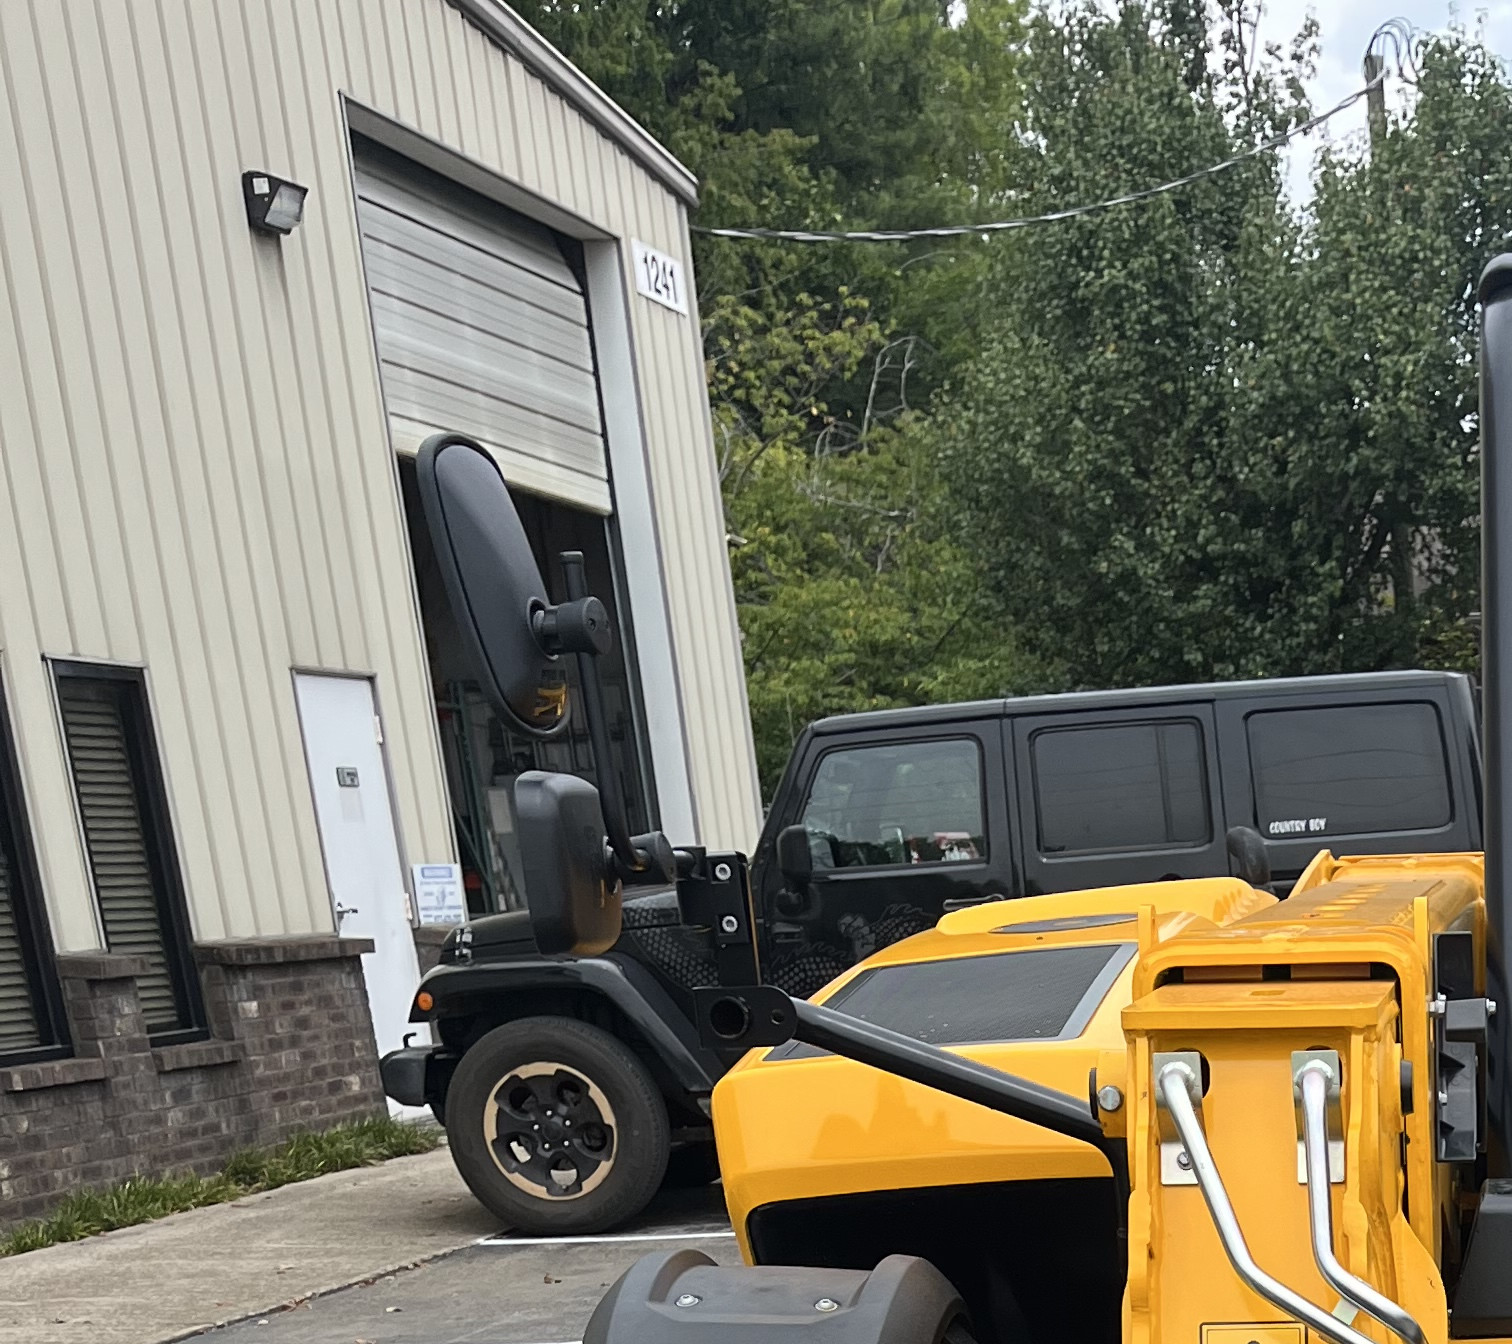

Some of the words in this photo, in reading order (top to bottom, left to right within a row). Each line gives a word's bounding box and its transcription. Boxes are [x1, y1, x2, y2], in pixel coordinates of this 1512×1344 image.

[642, 251, 679, 304] 1241
[1269, 819, 1306, 834] COUNTRY
[1309, 817, 1327, 831] BOY
